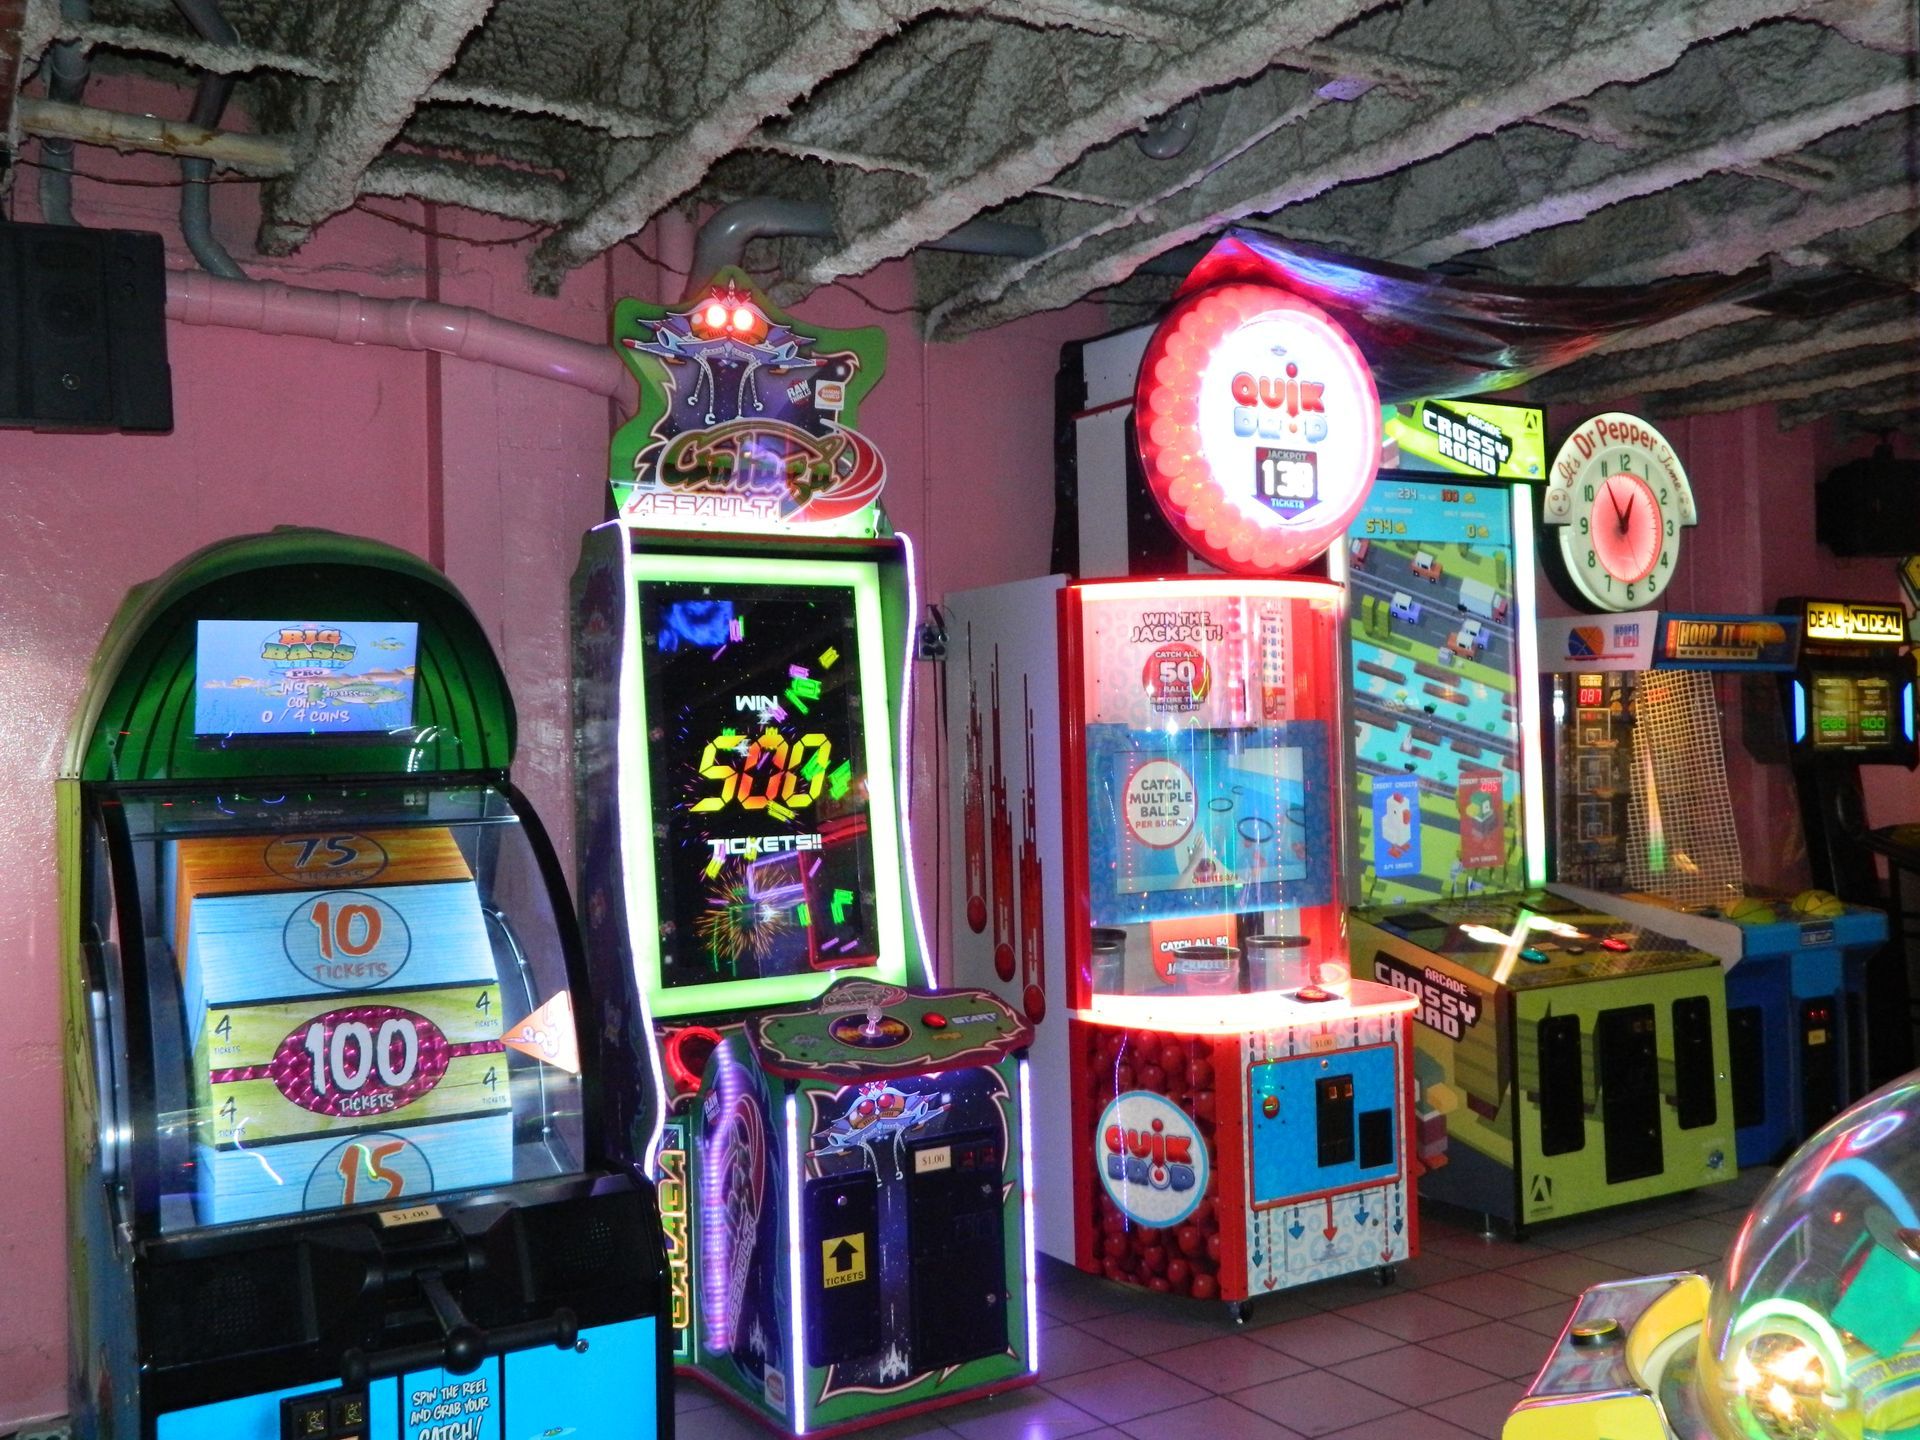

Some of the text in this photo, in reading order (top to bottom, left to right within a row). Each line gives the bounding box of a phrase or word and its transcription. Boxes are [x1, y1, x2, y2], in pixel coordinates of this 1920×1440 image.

[1467, 413, 1502, 438] ARCADE
[1422, 408, 1509, 463] CROSSY
[1267, 450, 1307, 460] JACKPOT
[1438, 434, 1498, 476] ROAD
[1573, 430, 1597, 460] Dr
[1595, 418, 1658, 452] Pepper
[1657, 445, 1682, 491] Time
[1620, 454, 1631, 471] 12
[1601, 461, 1608, 477] 11
[1584, 485, 1594, 501] 10
[1660, 488, 1667, 505] 2
[627, 493, 779, 519] ASSAULT
[1270, 498, 1306, 509] TICKETS
[1580, 517, 1588, 534] 9
[1666, 520, 1674, 536] 3
[1588, 550, 1596, 568] 8
[1660, 552, 1668, 568] 4
[1604, 574, 1612, 592] 7
[1626, 583, 1635, 600] 6
[1648, 575, 1656, 592] 5
[1143, 611, 1210, 626] WIN THE
[1809, 610, 1841, 628] DEAL
[1851, 612, 1869, 632] NO
[1870, 614, 1901, 633] DEAL
[279, 629, 342, 645] BIG
[1131, 624, 1223, 642] JACKPOT!
[1680, 623, 1718, 645] HOOP
[1721, 624, 1736, 646] IT
[261, 642, 356, 661] BASS
[1185, 650, 1200, 658] ALL
[1159, 660, 1196, 684] 50
[1163, 685, 1192, 693] BALLS
[1580, 689, 1603, 703] 087
[736, 695, 778, 711] WIN
[262, 711, 273, 723] 0
[294, 708, 306, 722] 4
[310, 711, 350, 723] COINS
[1861, 717, 1886, 729] 400
[690, 733, 832, 812] 500
[1141, 779, 1181, 790] CATCH
[1130, 792, 1193, 804] MULTPLE
[1135, 818, 1188, 829] PER BUCK
[283, 835, 360, 869] 75
[708, 833, 822, 856] TICKETS!!
[311, 901, 384, 962] 10
[1160, 936, 1228, 952] CATCH ALL 50
[313, 962, 390, 980] TICKETS
[1425, 967, 1468, 997] ARCADE
[1375, 961, 1476, 1024] CROSSY
[475, 991, 490, 1015] 4
[951, 1012, 997, 1024] START
[1412, 1002, 1459, 1039] OAD
[215, 1014, 232, 1042] 4
[214, 1045, 241, 1054] TICKETS
[305, 1018, 418, 1095] 100
[483, 1066, 497, 1092] 4
[219, 1096, 237, 1124] 4
[338, 1093, 395, 1112] TICKETS
[1105, 1118, 1192, 1168] QUIK
[922, 1153, 946, 1167] $1.00
[336, 1142, 407, 1205] 15
[1107, 1153, 1196, 1192] DROP
[392, 1209, 430, 1222] $1.00
[657, 1150, 689, 1329] GALAGA
[825, 1271, 865, 1287] TICKETS
[412, 1378, 488, 1406] SPIN THE REEL
[410, 1396, 490, 1426] AND GRAB YOUR
[418, 1415, 483, 1440] CATCH!
